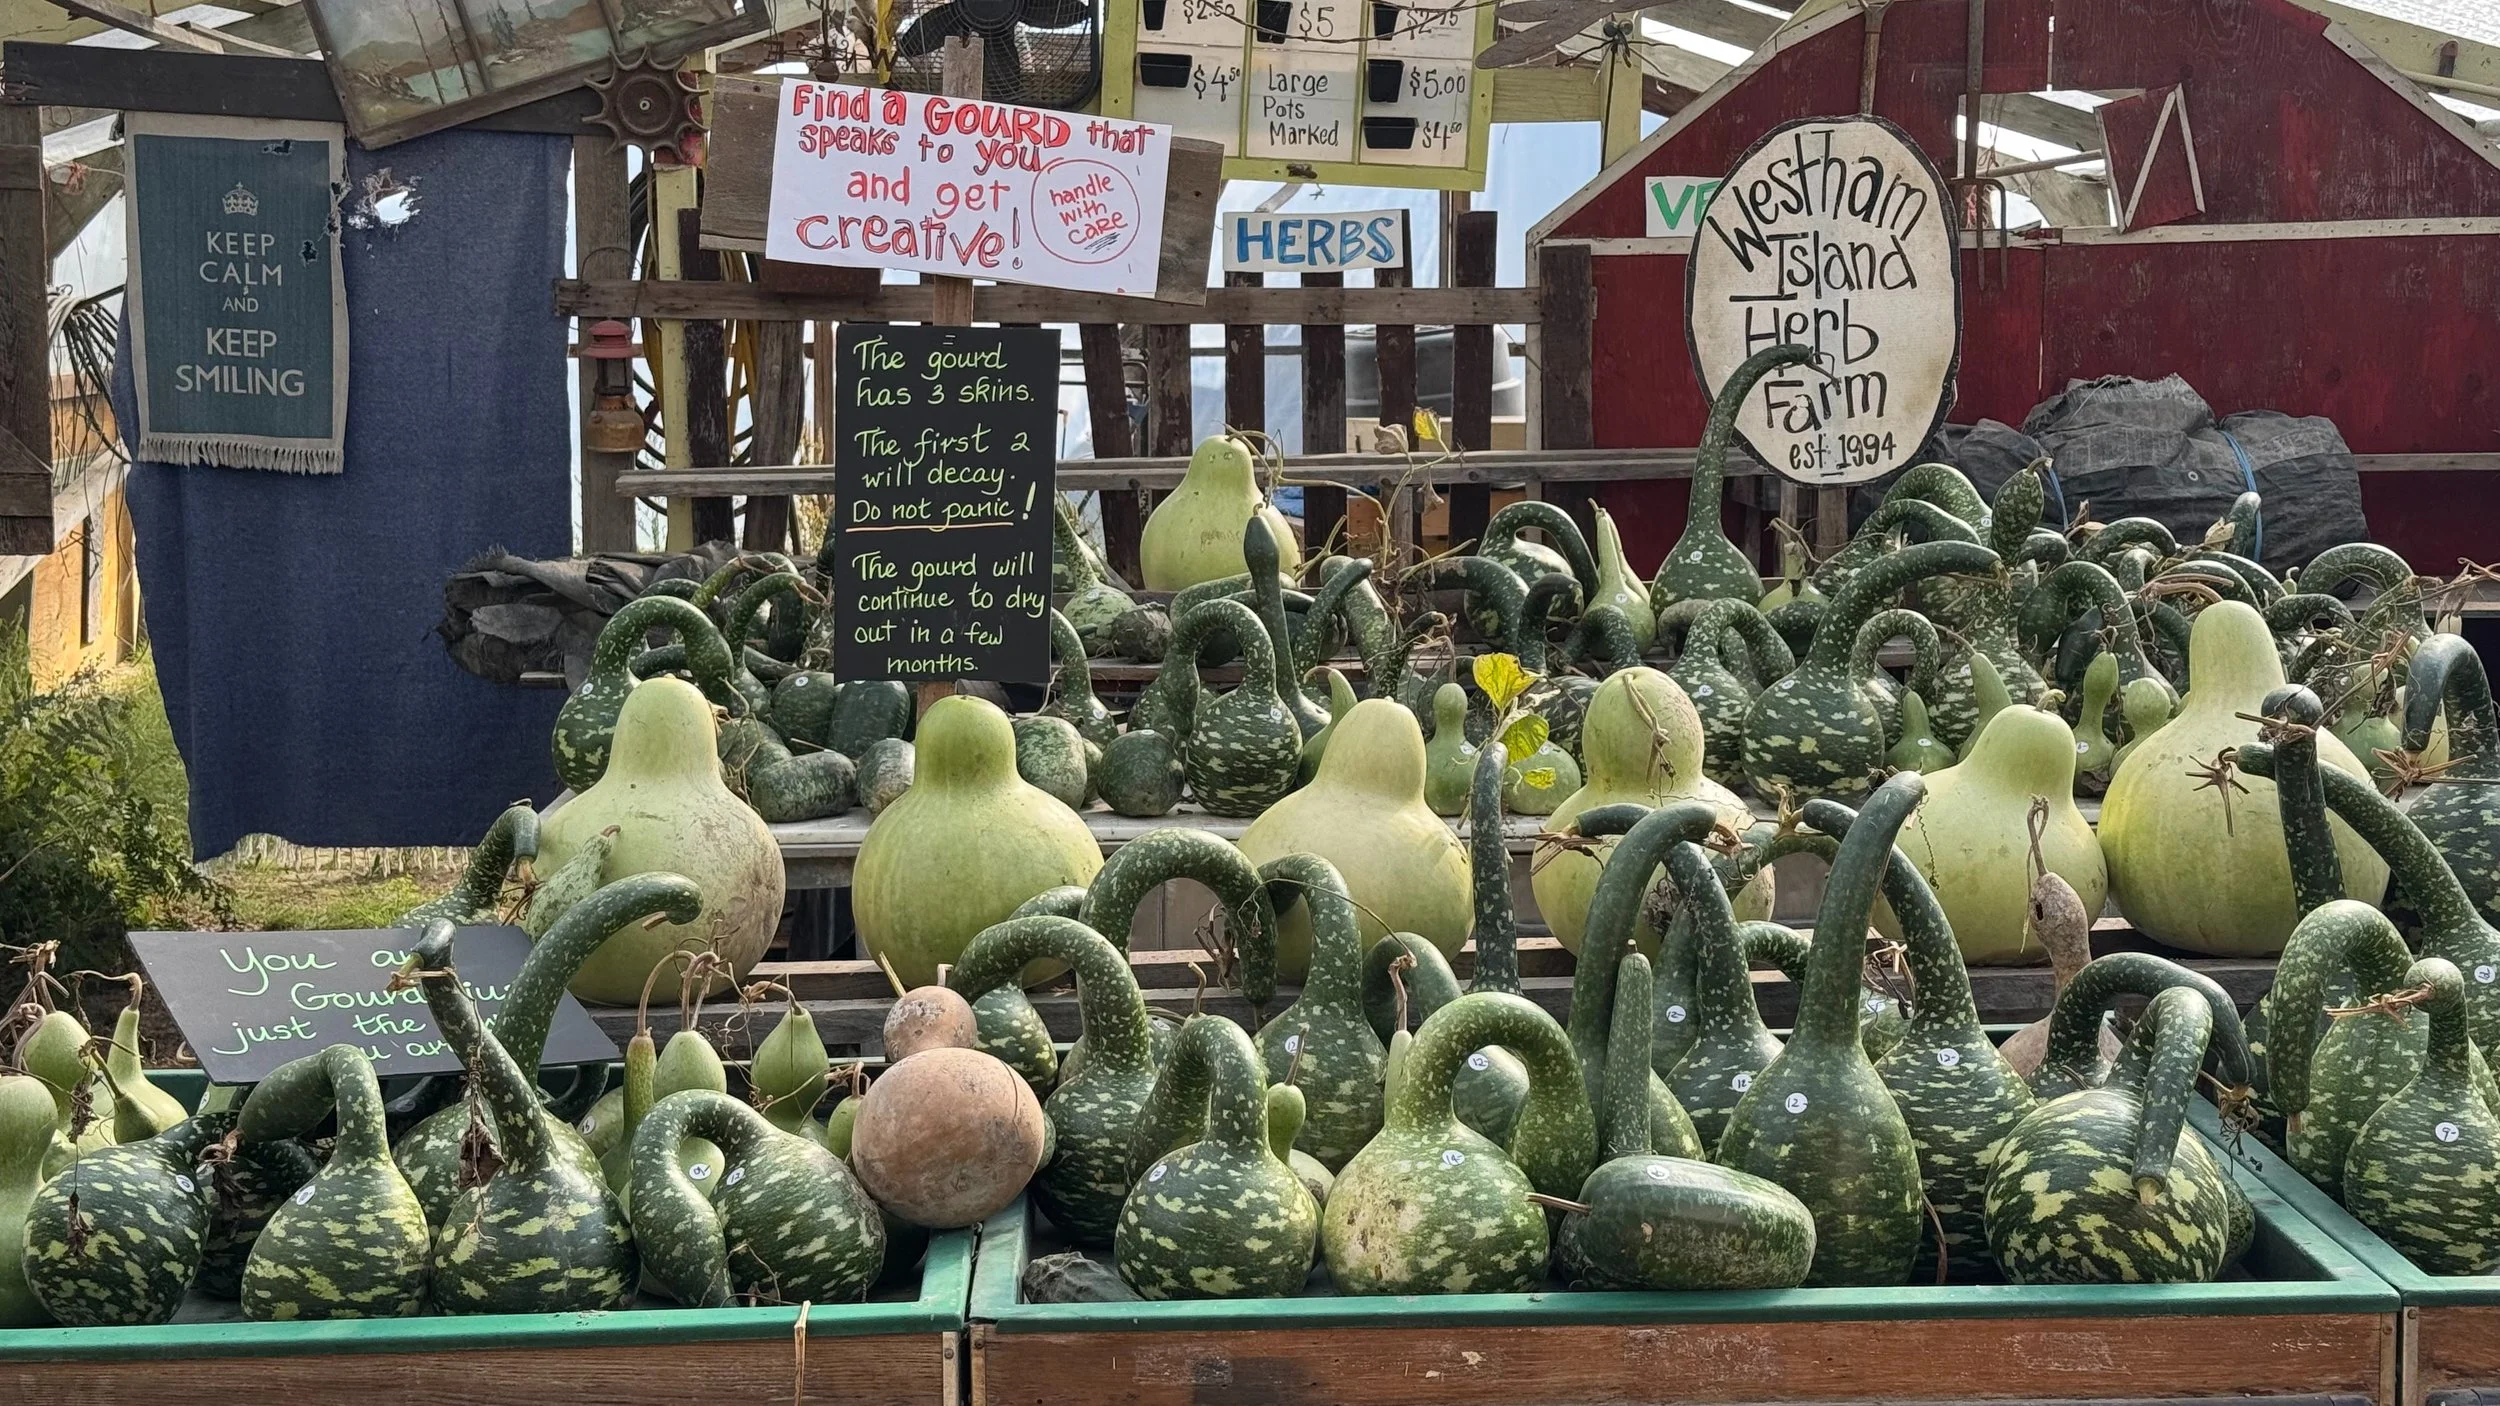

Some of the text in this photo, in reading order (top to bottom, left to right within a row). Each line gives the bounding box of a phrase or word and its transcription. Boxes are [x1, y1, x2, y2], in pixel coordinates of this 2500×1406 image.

[1299, 1, 1335, 42] $5
[1268, 64, 1329, 97] Large
[1410, 66, 1465, 99] $5.00
[793, 84, 1155, 156] Find a GOURD that
[1263, 95, 1305, 120] Pots
[798, 123, 1041, 176] speaks to you
[1270, 119, 1339, 147] Marked
[847, 166, 1011, 219] and get
[1050, 173, 1114, 207] handle
[1707, 130, 1928, 272] Westham
[1059, 199, 1107, 228] with
[206, 232, 275, 256] KEEP
[796, 206, 1024, 270] creative!
[1237, 216, 1395, 267] HERBS
[199, 261, 282, 286] CALM
[1729, 231, 1917, 302] Island
[222, 297, 258, 313] AND
[206, 328, 277, 358] KEEP
[853, 335, 1008, 381] The gourd
[175, 365, 305, 396] SMILING
[857, 377, 1035, 407] has 3 skins.
[1764, 371, 1887, 433] Farm
[854, 423, 1031, 467] The first 2
[1837, 431, 1896, 469] 1994
[862, 459, 1016, 495] will decay.
[852, 500, 881, 523] Do
[893, 498, 932, 520] not
[852, 551, 1034, 592] The gourd will
[858, 581, 1045, 618] continue to dry
[854, 620, 1003, 645] out in a few
[887, 648, 979, 674] months.
[220, 947, 412, 996] You ar
[212, 1015, 317, 1055] just
[353, 1013, 426, 1036] the
